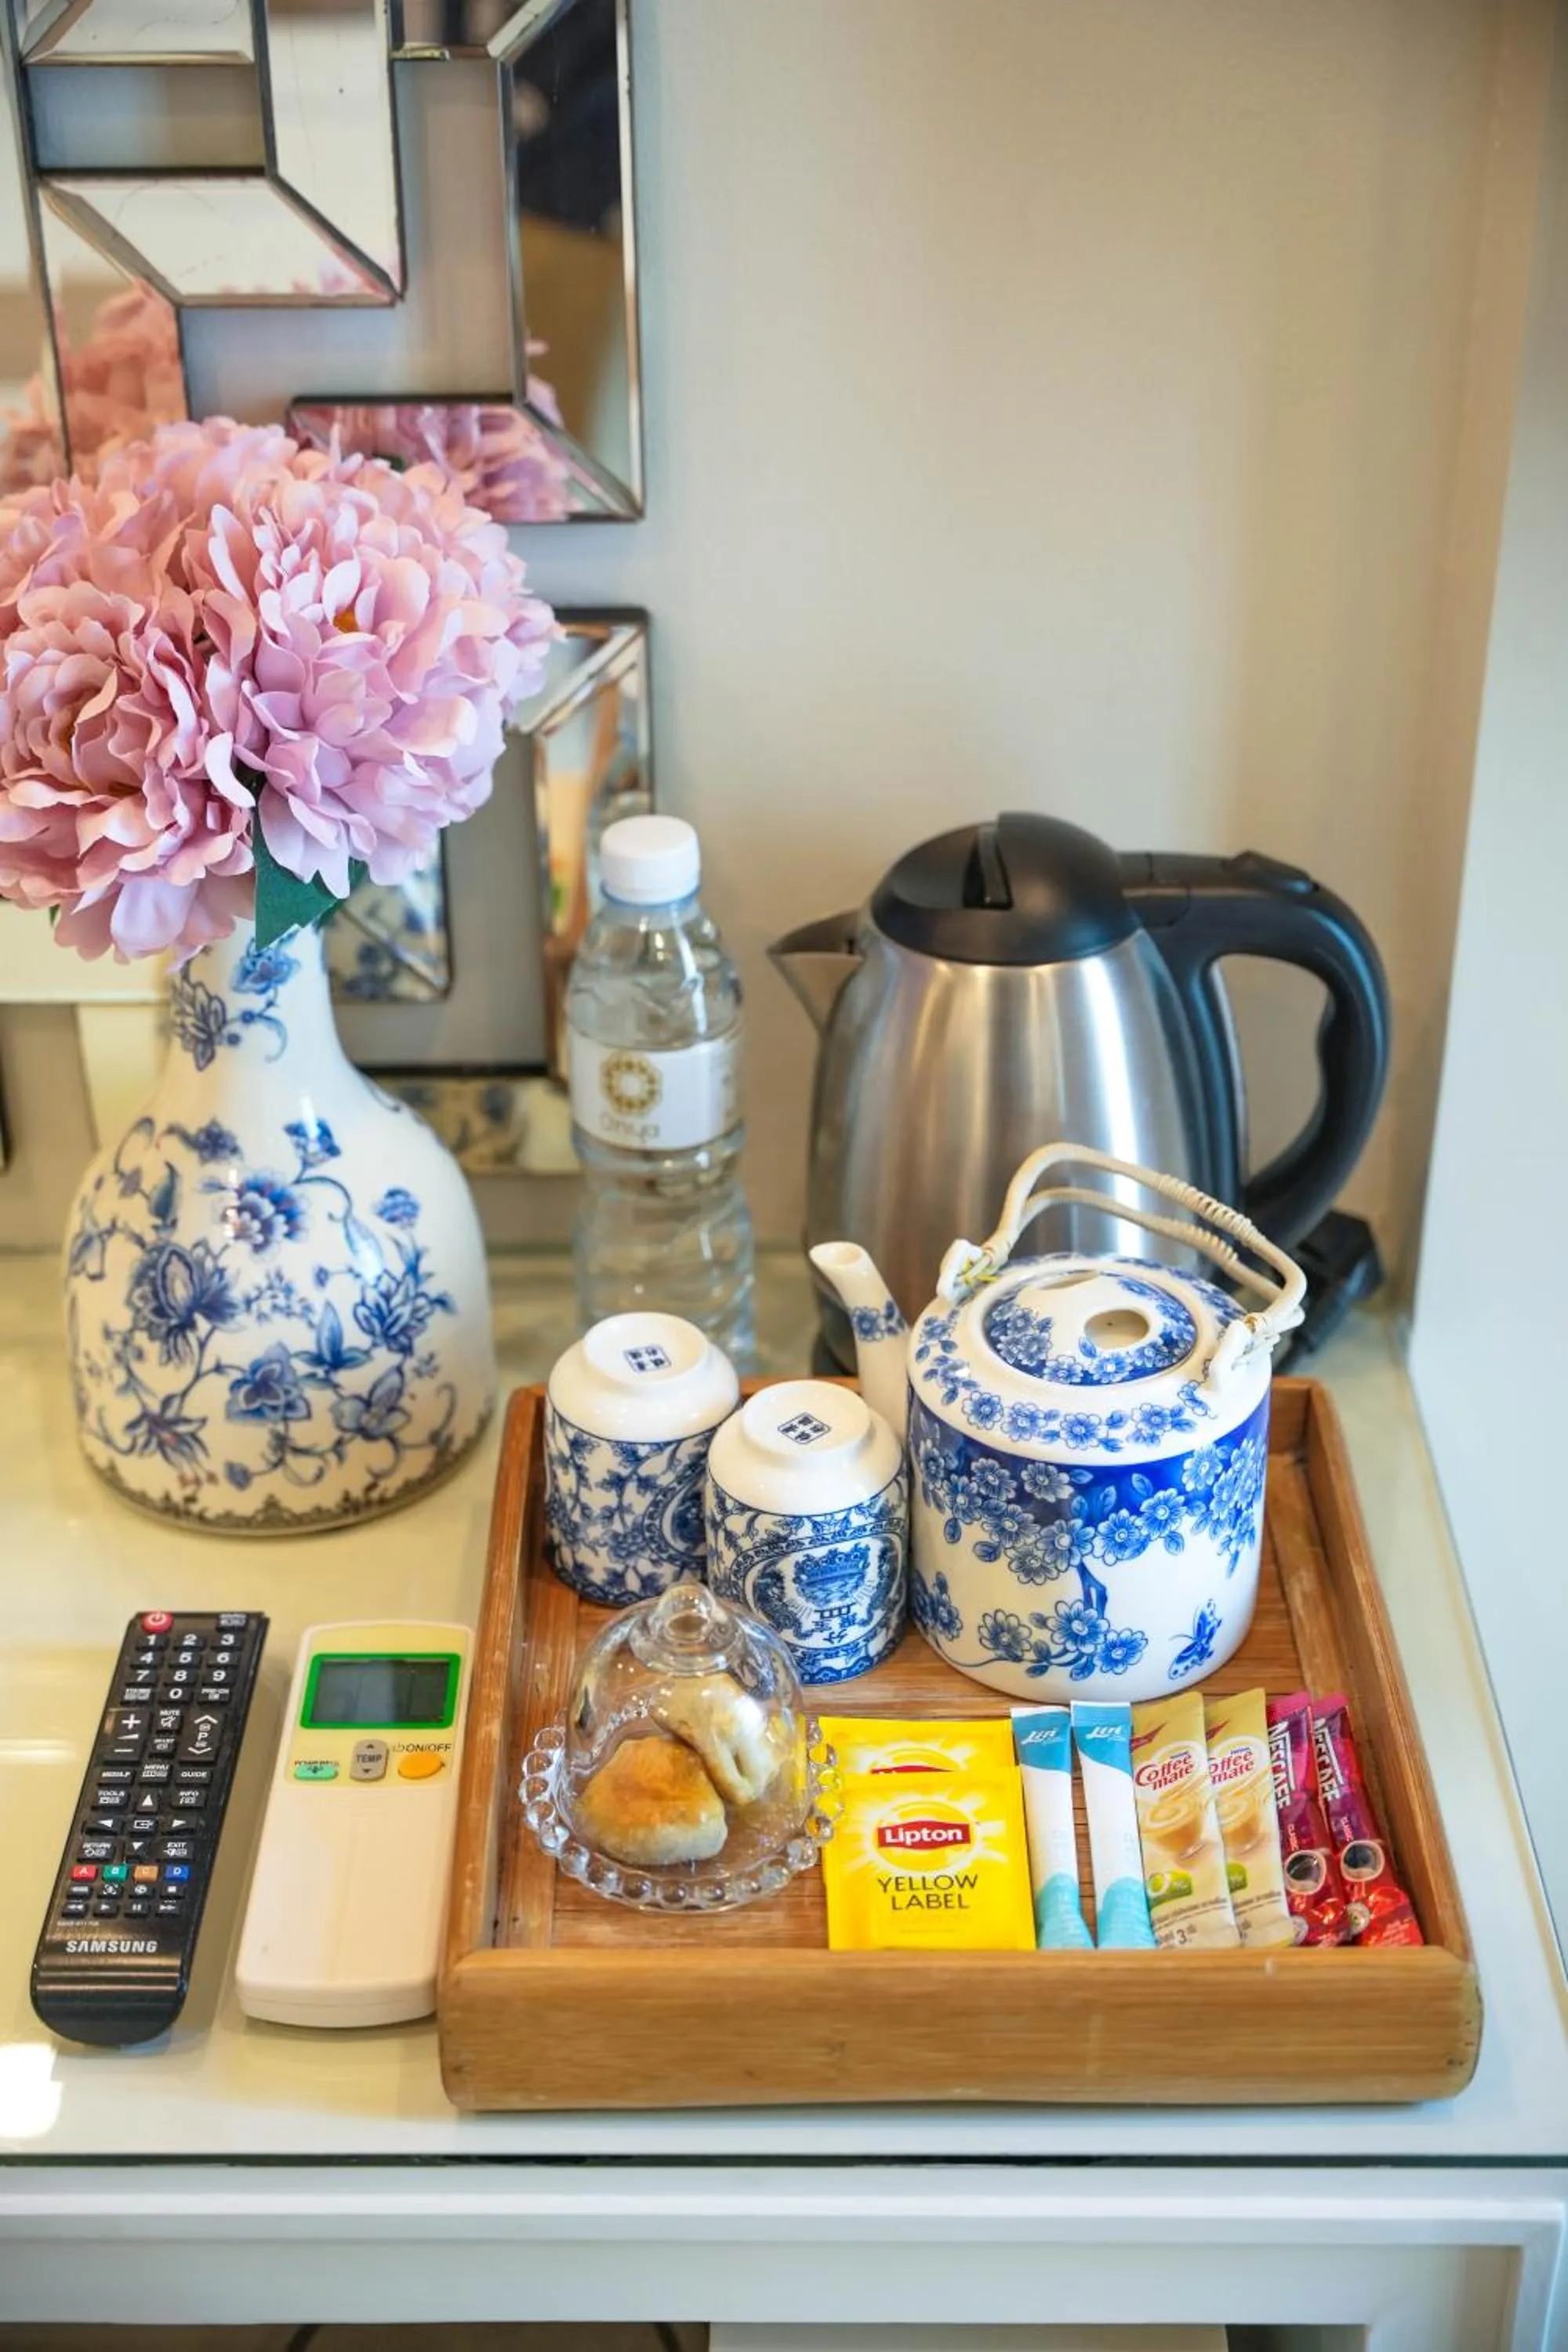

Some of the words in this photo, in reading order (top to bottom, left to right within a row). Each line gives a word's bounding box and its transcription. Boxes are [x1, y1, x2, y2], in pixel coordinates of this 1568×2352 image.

[147, 1634, 157, 1646] 1
[182, 1634, 197, 1646] 2
[220, 1634, 234, 1646] 3
[140, 1652, 154, 1664] 4
[179, 1652, 192, 1663] 5
[216, 1652, 230, 1663] 6
[136, 1670, 150, 1681] 7
[173, 1670, 187, 1681] 8
[212, 1670, 226, 1681] 9
[197, 1733, 208, 1741] P
[356, 1754, 382, 1764] TEMP
[1134, 1754, 1192, 1787] Coffee
[1153, 1764, 1193, 1791] mate
[1211, 1761, 1254, 1784] mate
[884, 1828, 963, 1846] Lipton
[877, 1874, 978, 1893] YELLOW
[891, 1893, 971, 1911] LABEL
[66, 1940, 158, 1954] SAMSUNG
